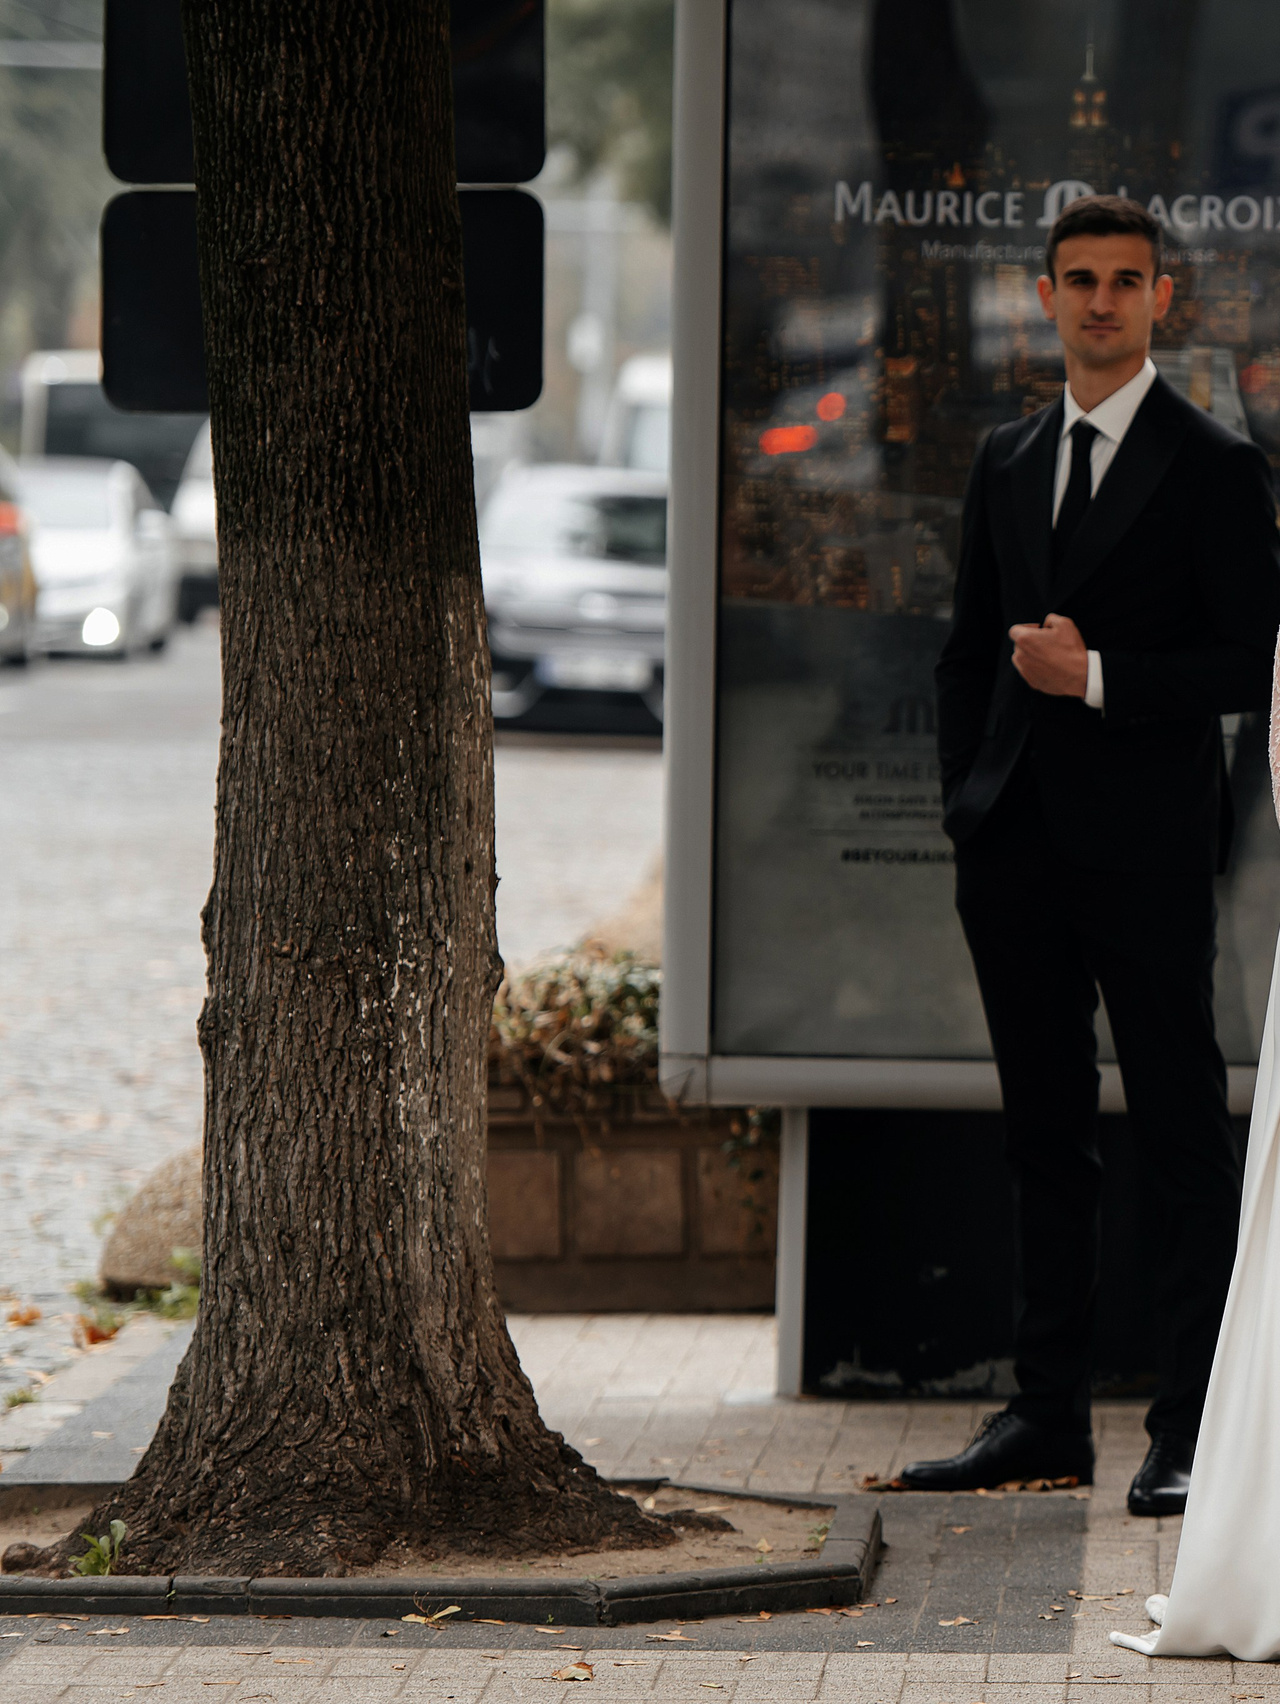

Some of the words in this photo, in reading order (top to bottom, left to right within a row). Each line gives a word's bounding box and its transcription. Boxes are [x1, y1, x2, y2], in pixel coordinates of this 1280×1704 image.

[834, 180, 1023, 228] MAURICE
[813, 761, 868, 780] YOUR
[877, 762, 921, 780] TIME
